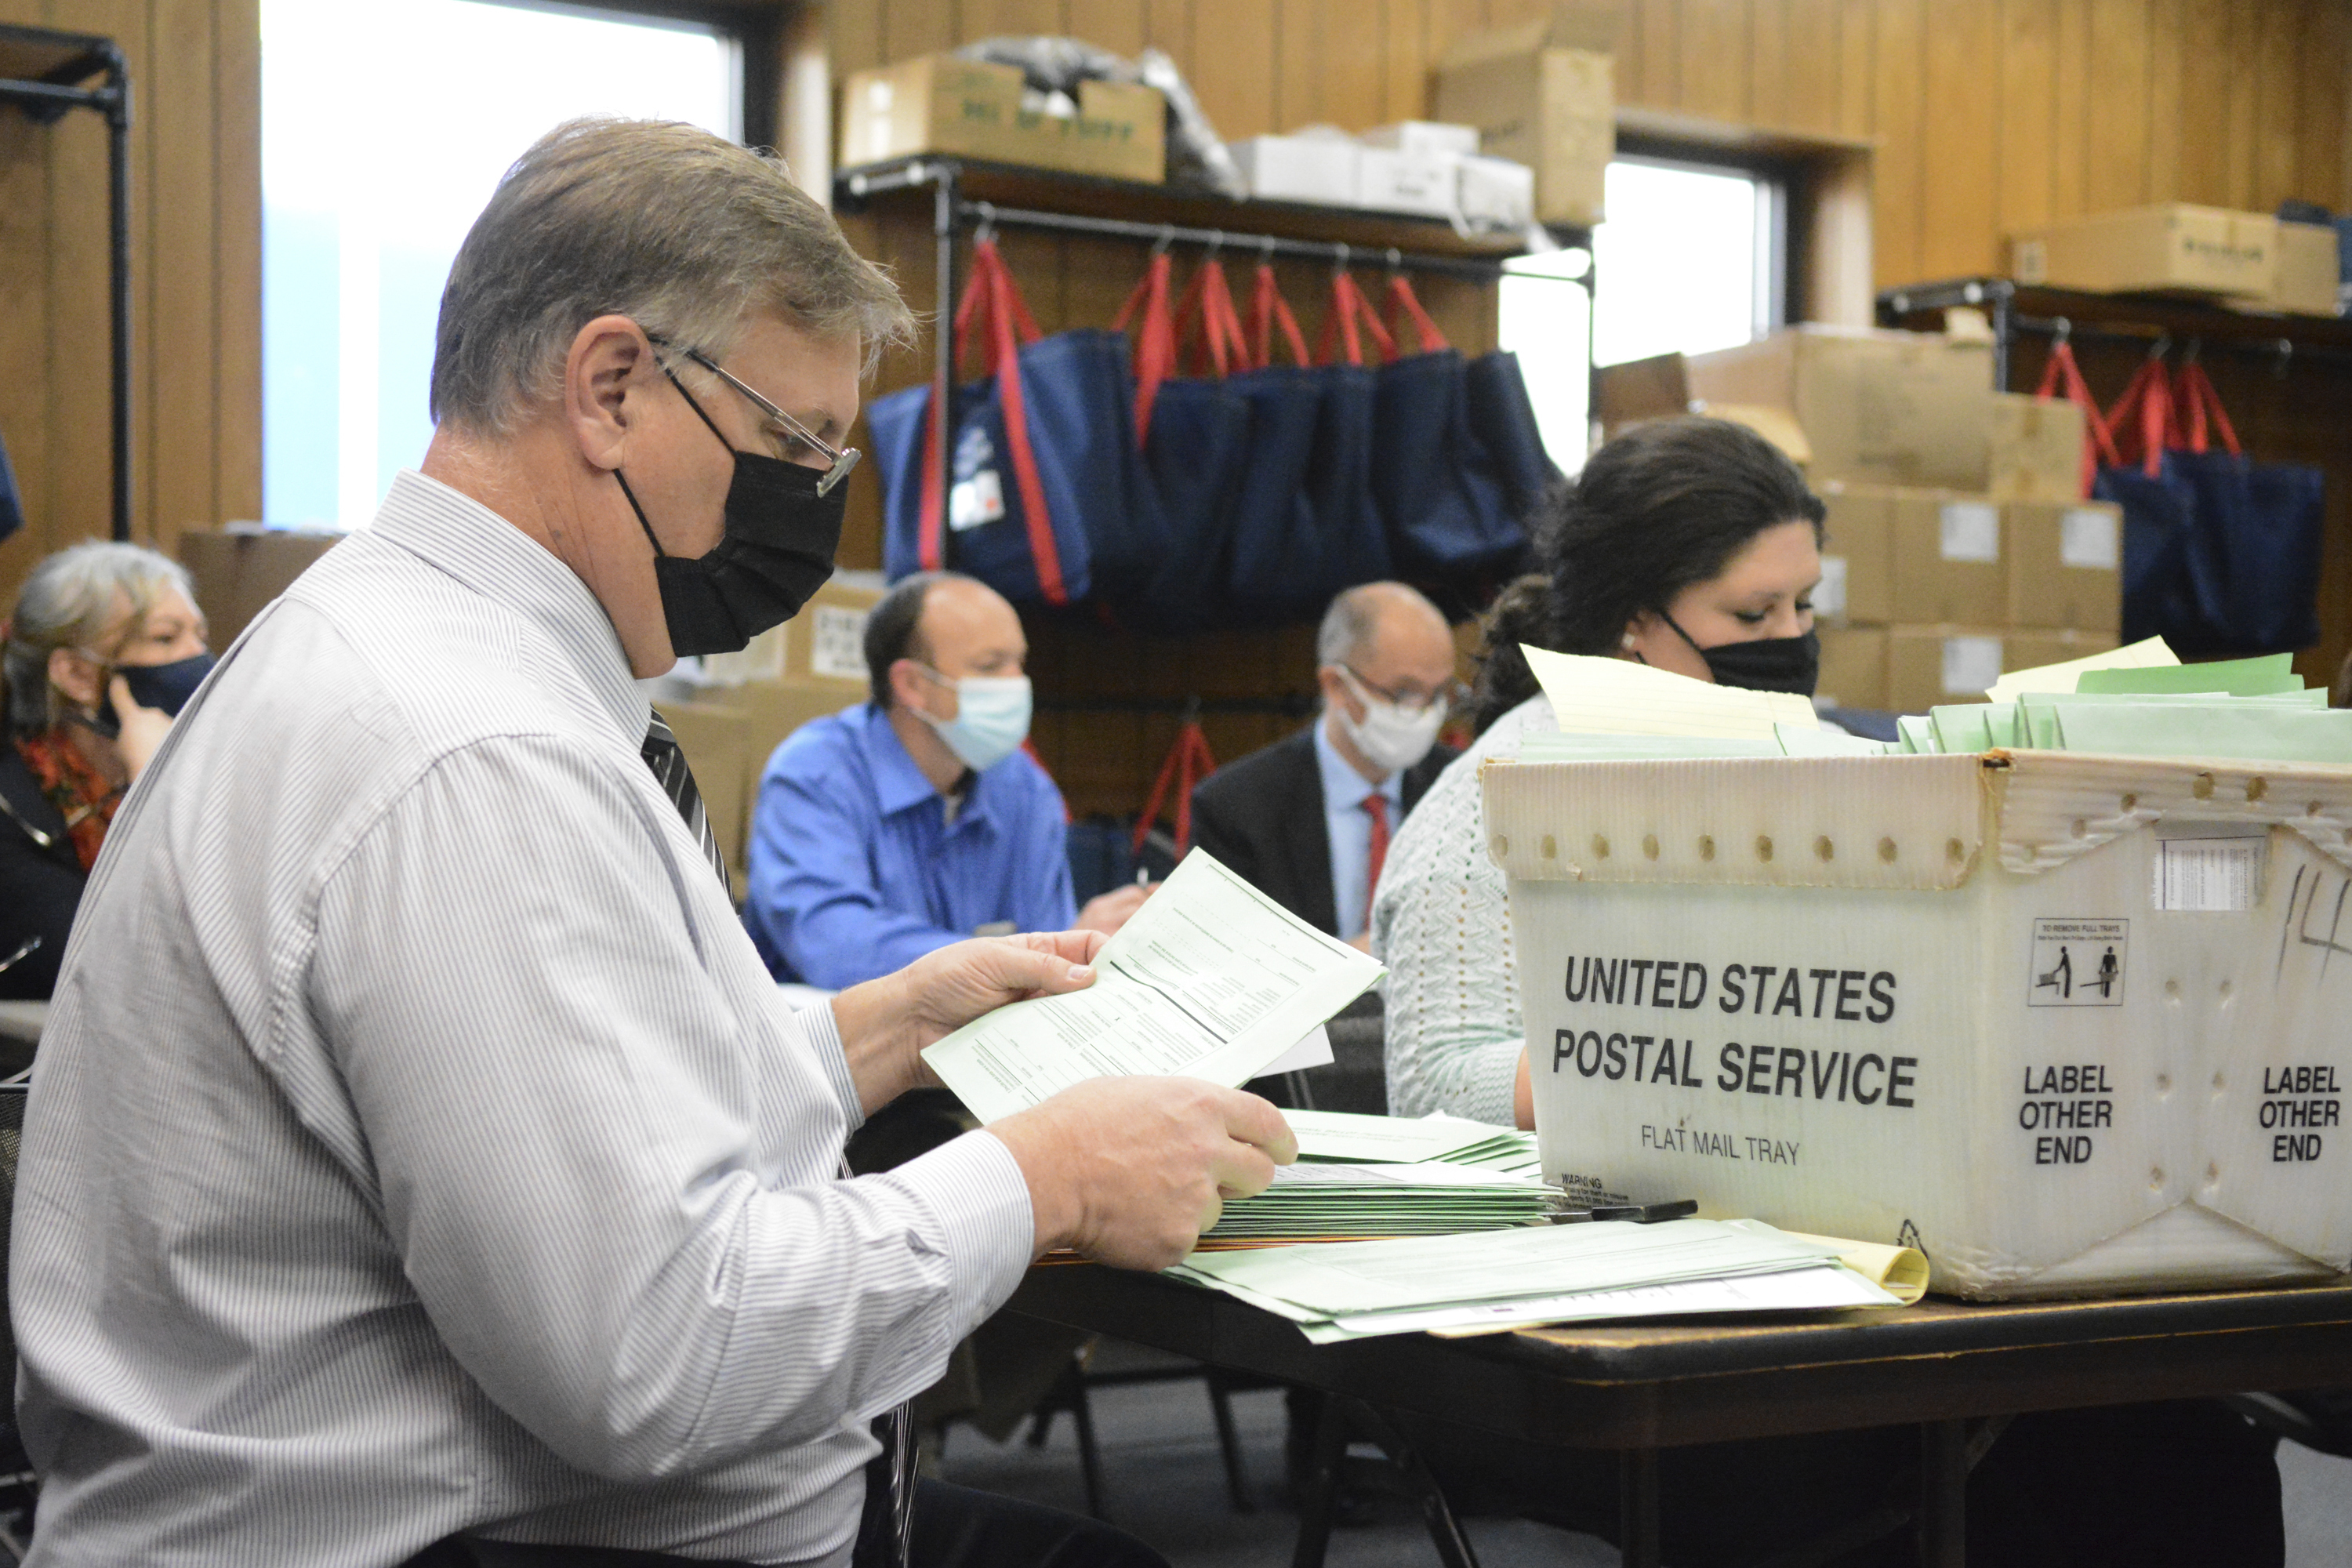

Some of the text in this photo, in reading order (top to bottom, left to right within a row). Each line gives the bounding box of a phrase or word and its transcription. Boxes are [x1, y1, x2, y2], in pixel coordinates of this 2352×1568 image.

[1565, 956, 1897, 1023] UNITED STATES
[1553, 1029, 1918, 1108] POSTAL SERVICE
[2024, 1065, 2114, 1094] LABEL
[2263, 1066, 2342, 1094] LABEL
[2019, 1100, 2114, 1131] OTHER
[2259, 1100, 2342, 1129] OTHER
[1642, 1124, 1800, 1166] FLAT MAIL TRAY
[2035, 1135, 2093, 1165] END
[2273, 1134, 2322, 1163] END
[1561, 1173, 1602, 1189] WARNING
